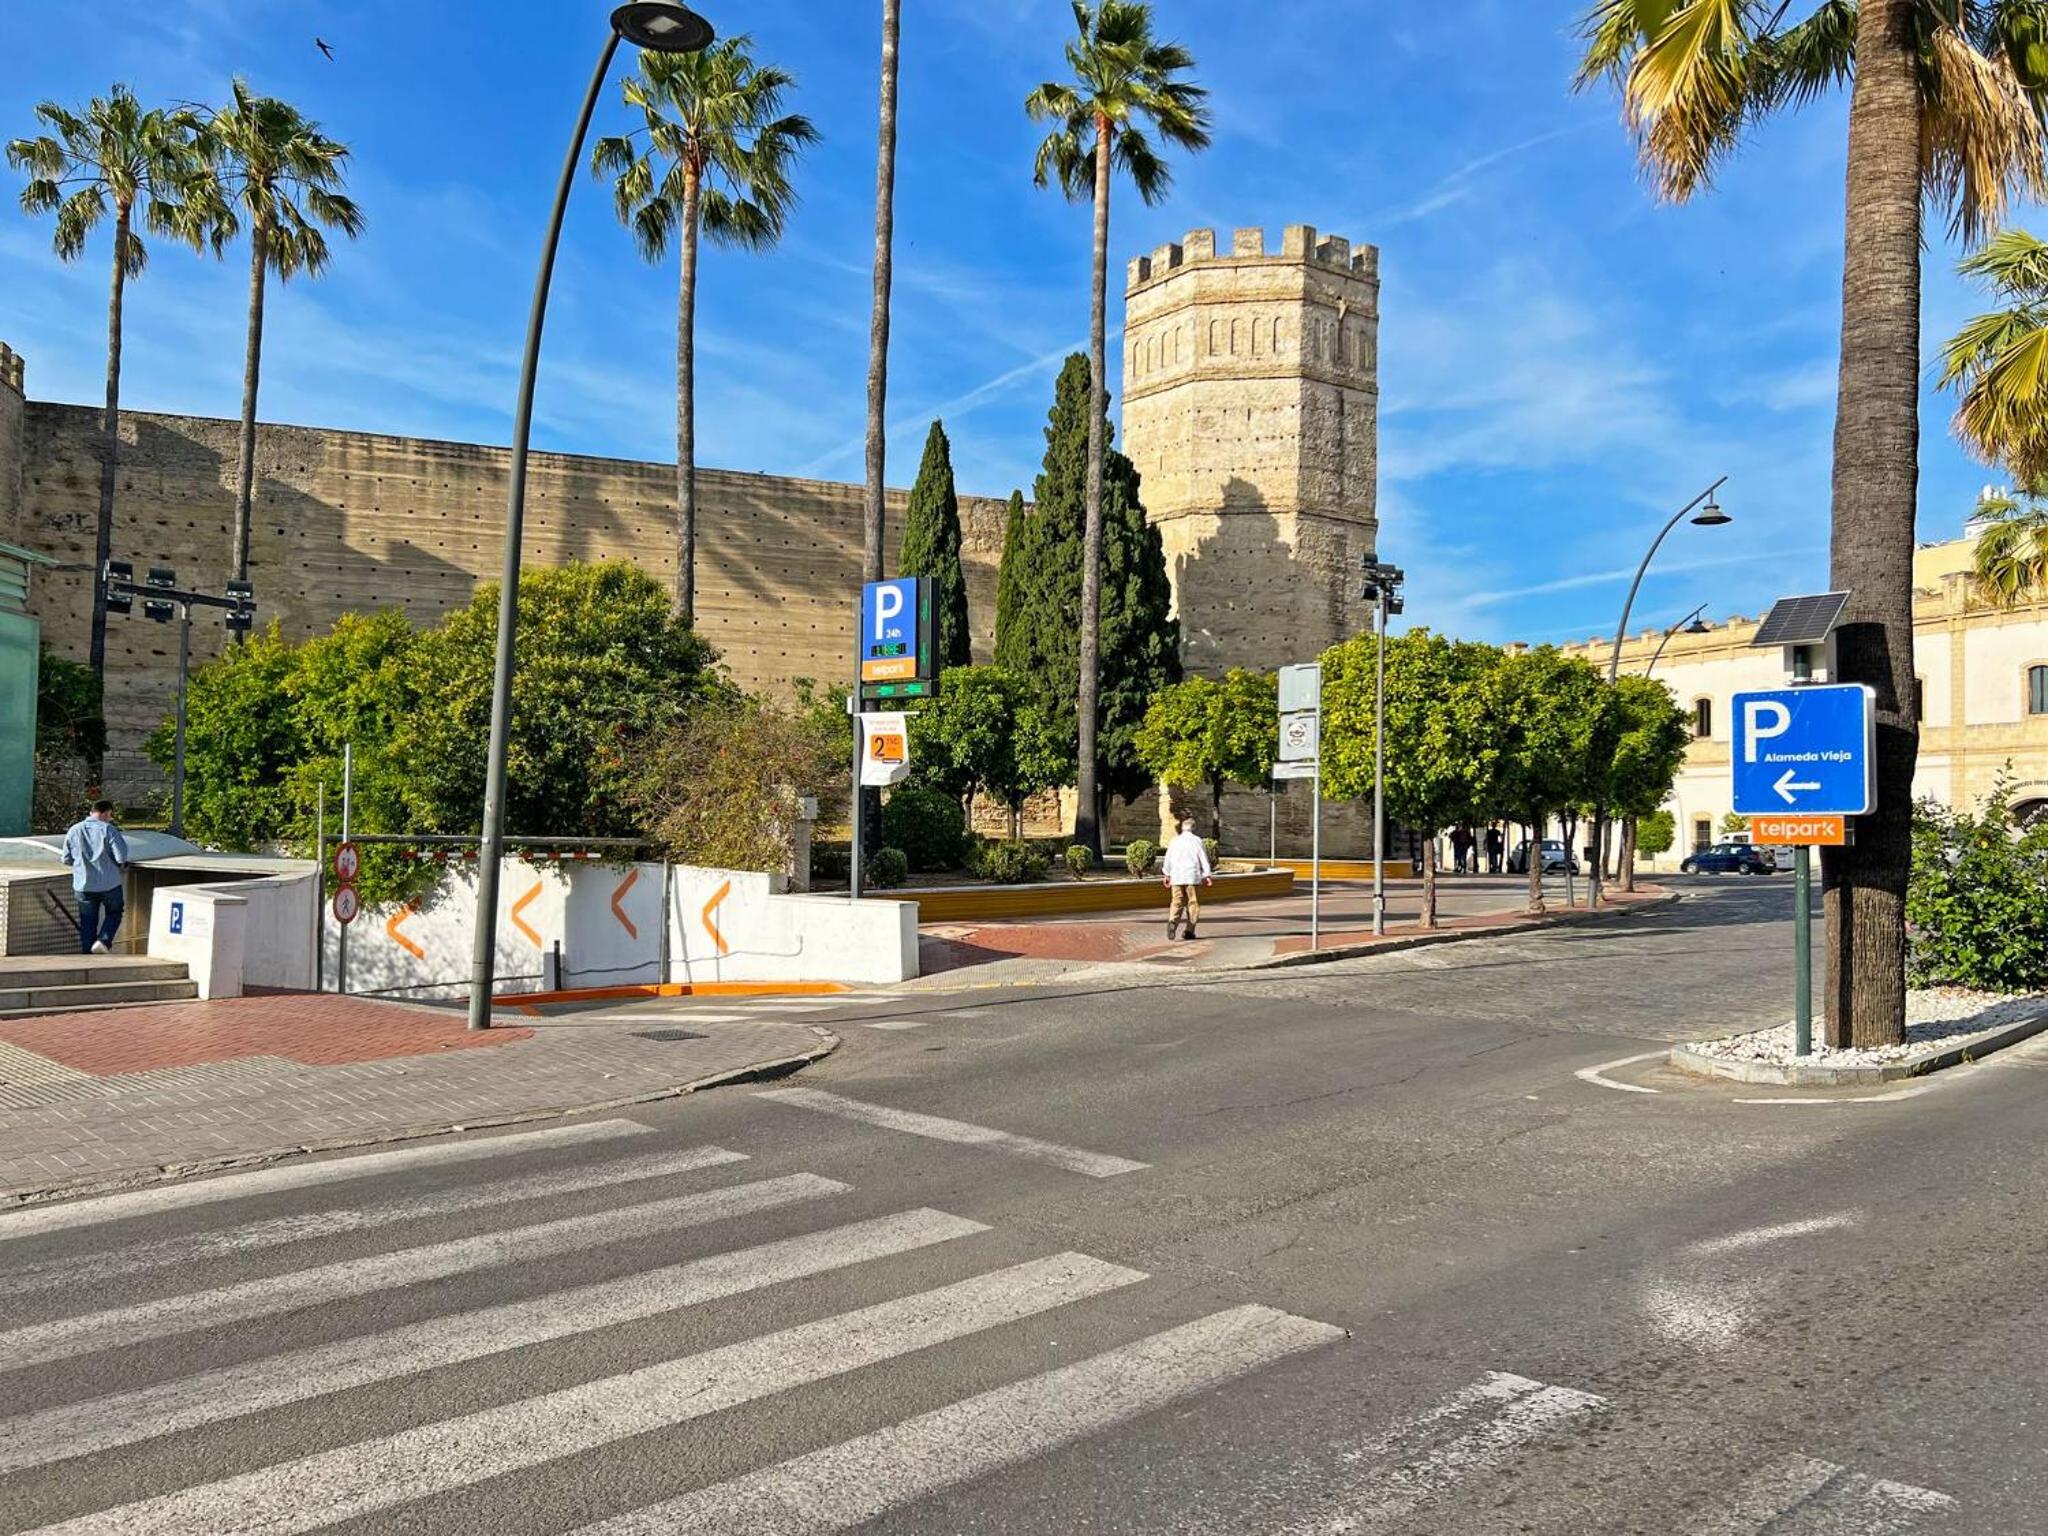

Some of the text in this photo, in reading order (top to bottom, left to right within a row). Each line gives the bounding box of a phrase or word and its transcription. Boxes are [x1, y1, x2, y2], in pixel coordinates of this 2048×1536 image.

[875, 585, 903, 640] P
[1744, 701, 1791, 763] P
[875, 737, 885, 757] 2
[1764, 750, 1852, 762] Alameda Vieja
[1760, 821, 1835, 839] telpark
